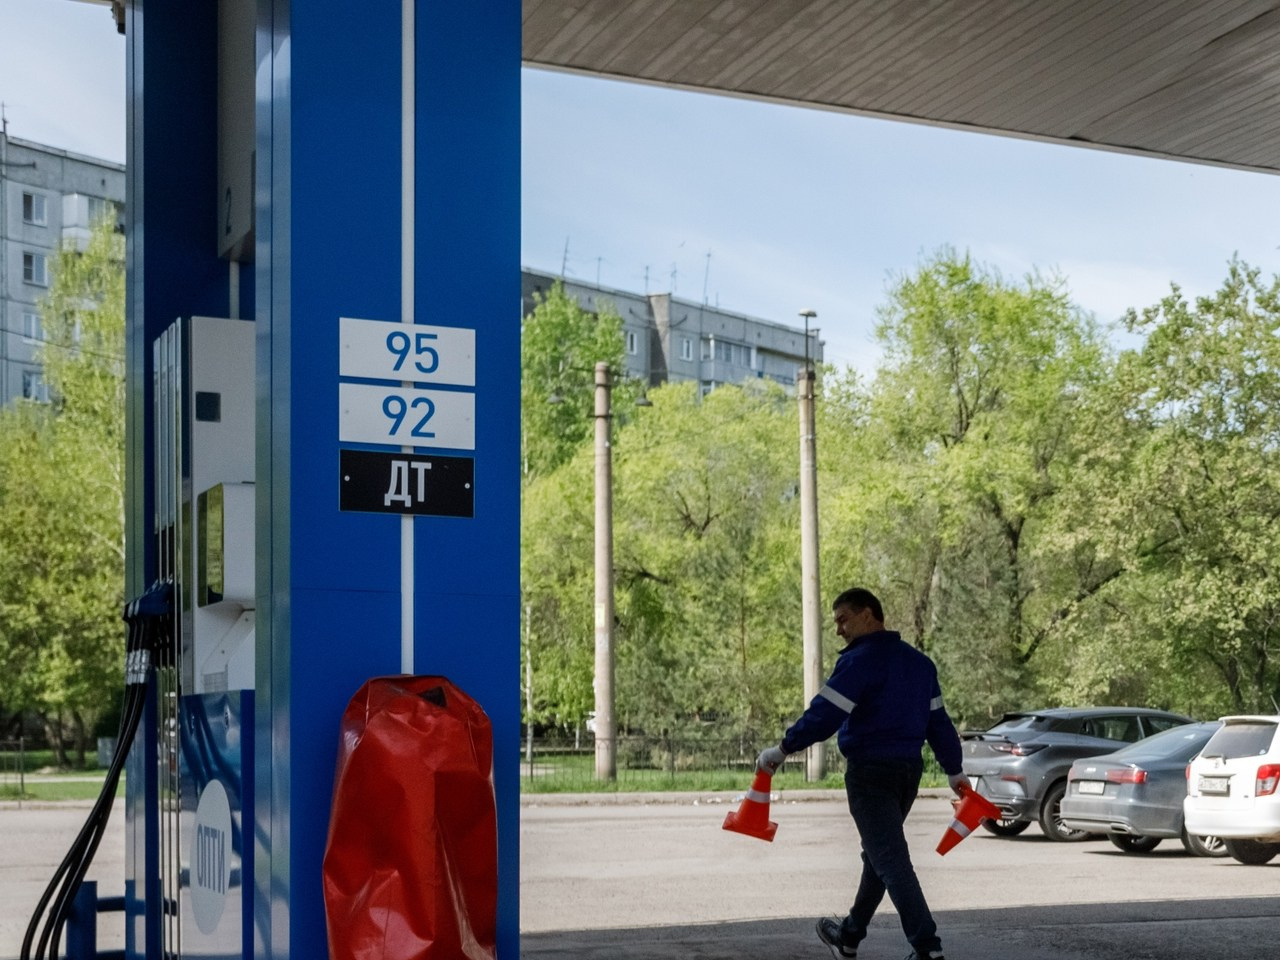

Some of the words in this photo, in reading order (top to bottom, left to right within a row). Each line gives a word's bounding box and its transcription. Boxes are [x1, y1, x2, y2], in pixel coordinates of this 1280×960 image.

[385, 330, 440, 374] 95
[381, 394, 436, 438] 92
[383, 460, 433, 507] ДТ
[197, 824, 225, 895] ОПТИ
